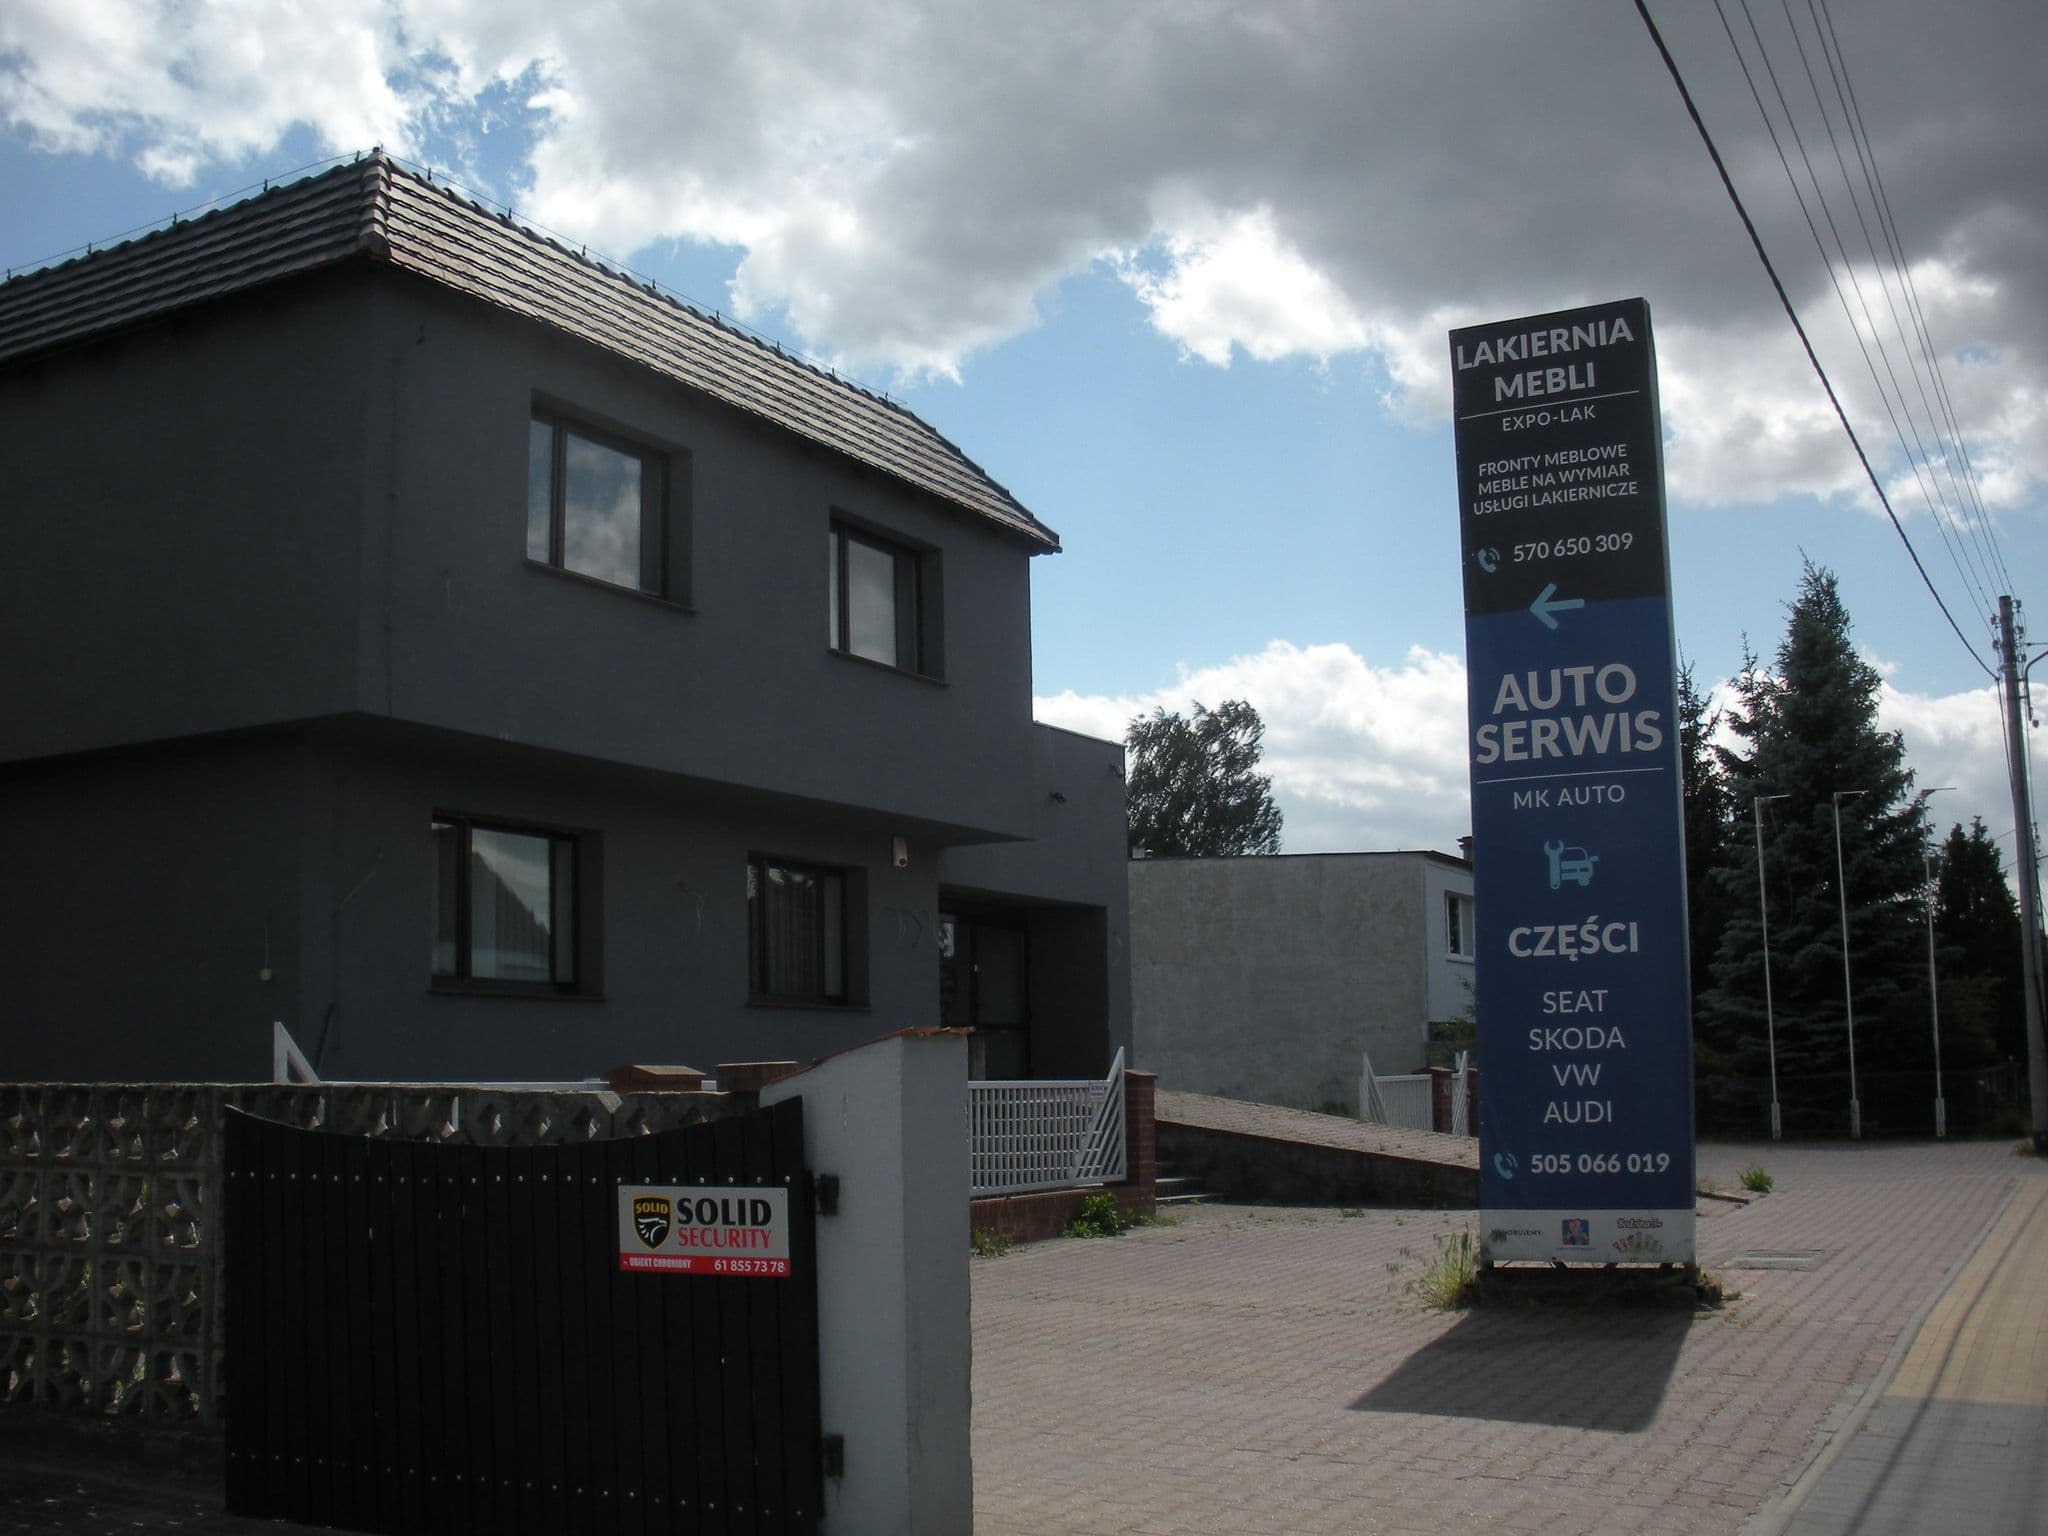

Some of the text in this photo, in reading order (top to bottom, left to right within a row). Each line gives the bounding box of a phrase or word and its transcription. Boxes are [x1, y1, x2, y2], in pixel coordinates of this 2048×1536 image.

[1457, 318, 1634, 371] LAKIERNIA
[1494, 362, 1596, 402] MEBLI
[1502, 405, 1596, 431] EXPO-LAK
[1478, 444, 1627, 476] FRONTY MEBLOWE
[1478, 463, 1630, 496] MEBLE NA WYMIAR
[1473, 481, 1638, 515] USŁUGI LAKIERNICZE
[1513, 532, 1633, 562] 570 650 309
[1492, 663, 1637, 715] AUTO
[1476, 710, 1663, 764] SERWIS
[1513, 784, 1626, 809] MK AUTO
[1508, 915, 1639, 961] CZĘŚCI
[1542, 989, 1609, 1014] SEAT
[1529, 1026, 1626, 1050] SKODA
[1552, 1063, 1601, 1087] VW
[1543, 1101, 1613, 1123] AUDI
[1531, 1153, 1671, 1174] 505 066 019
[635, 1202, 668, 1214] SOLID
[677, 1198, 772, 1227] SOLID
[677, 1228, 772, 1249] SECURITY
[714, 1259, 785, 1273] 61 855 73 78
